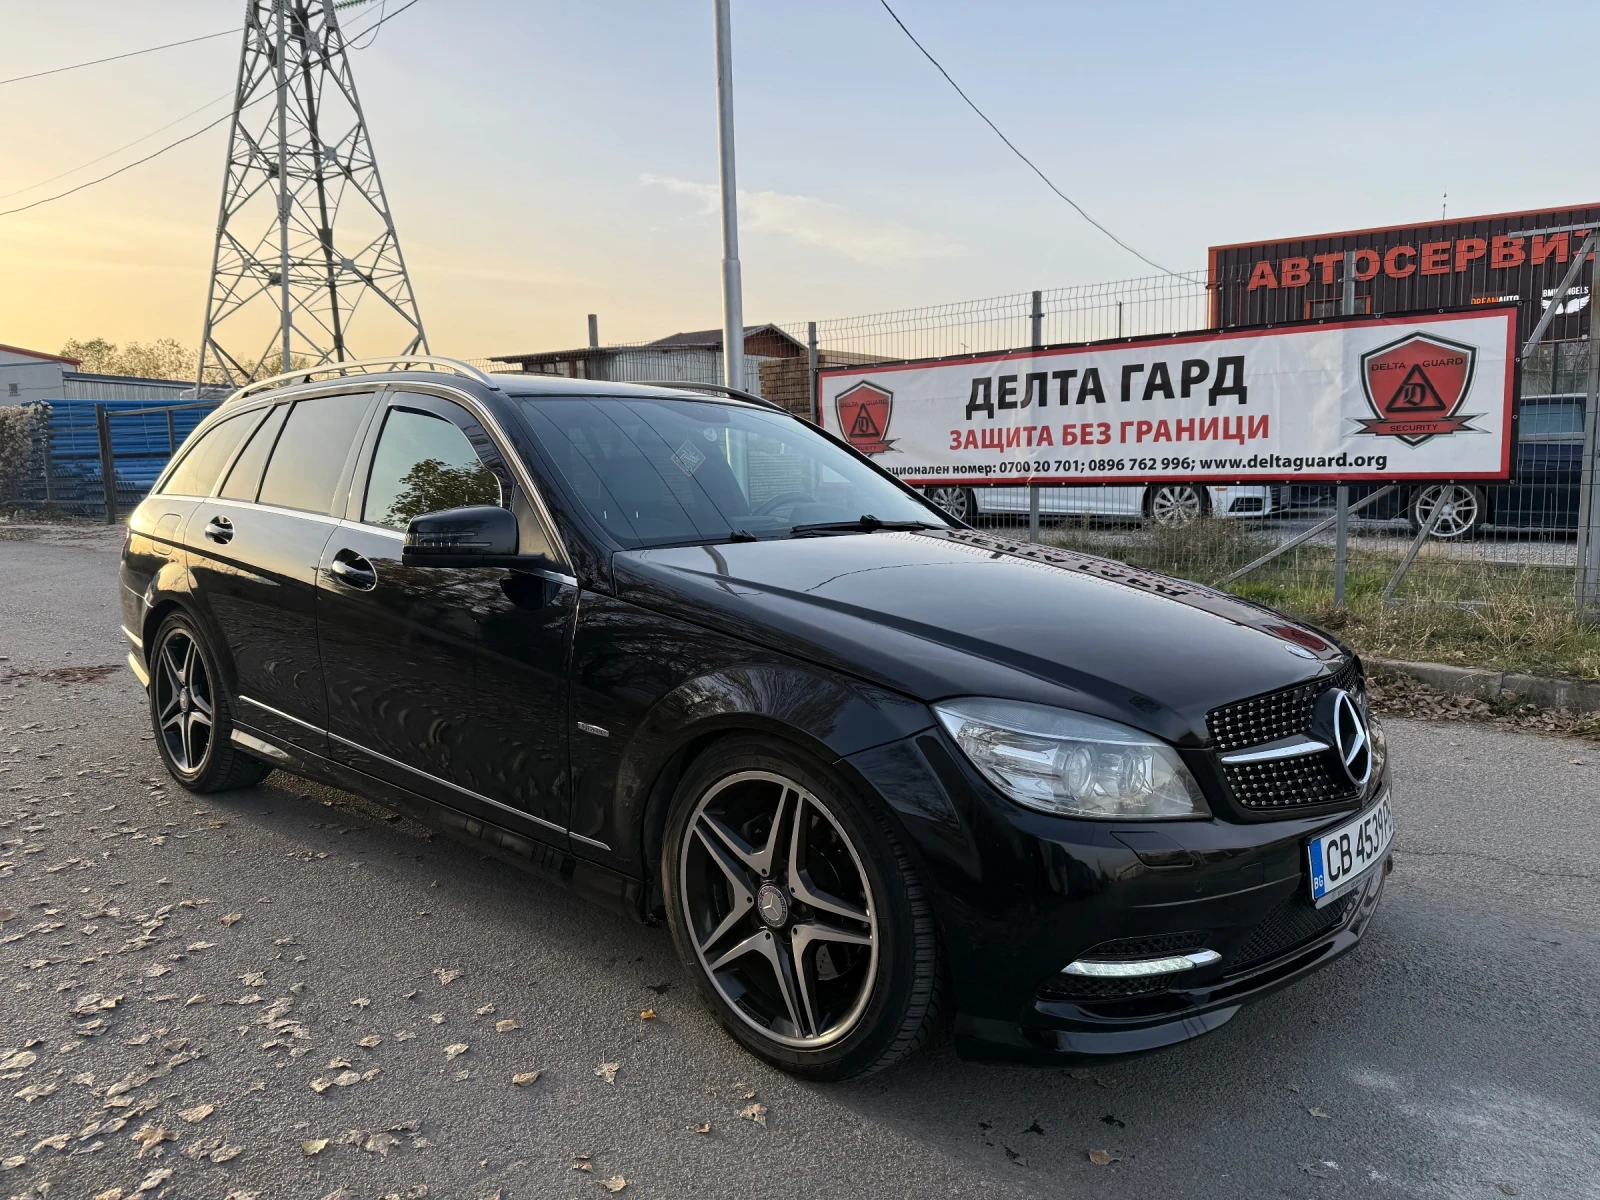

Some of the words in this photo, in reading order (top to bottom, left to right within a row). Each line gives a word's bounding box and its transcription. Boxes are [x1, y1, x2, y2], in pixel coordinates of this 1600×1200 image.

[1565, 286, 1590, 295] NGELS
[1371, 362, 1406, 371] DELTA
[1422, 357, 1463, 368] GUARD
[965, 367, 1106, 420] ДЕЛТА
[1121, 355, 1248, 406] ГАРД
[949, 425, 1054, 453] ЗАЩИТА
[1062, 422, 1112, 446] БЕЗ
[1120, 414, 1269, 445] ГРАНИЦИ
[1390, 424, 1438, 432] SECURITY
[886, 466, 949, 477] ационален
[952, 463, 997, 476] номер:
[999, 461, 1031, 473] 0700
[1033, 461, 1051, 473] 20
[1054, 460, 1085, 474] 701;
[1088, 459, 1125, 471] 0896
[1129, 458, 1157, 470] 762
[1160, 456, 1196, 471] 996;
[1199, 452, 1388, 471] www.deltaguard.org
[1326, 833, 1353, 882] CB
[1314, 875, 1324, 890] BG
